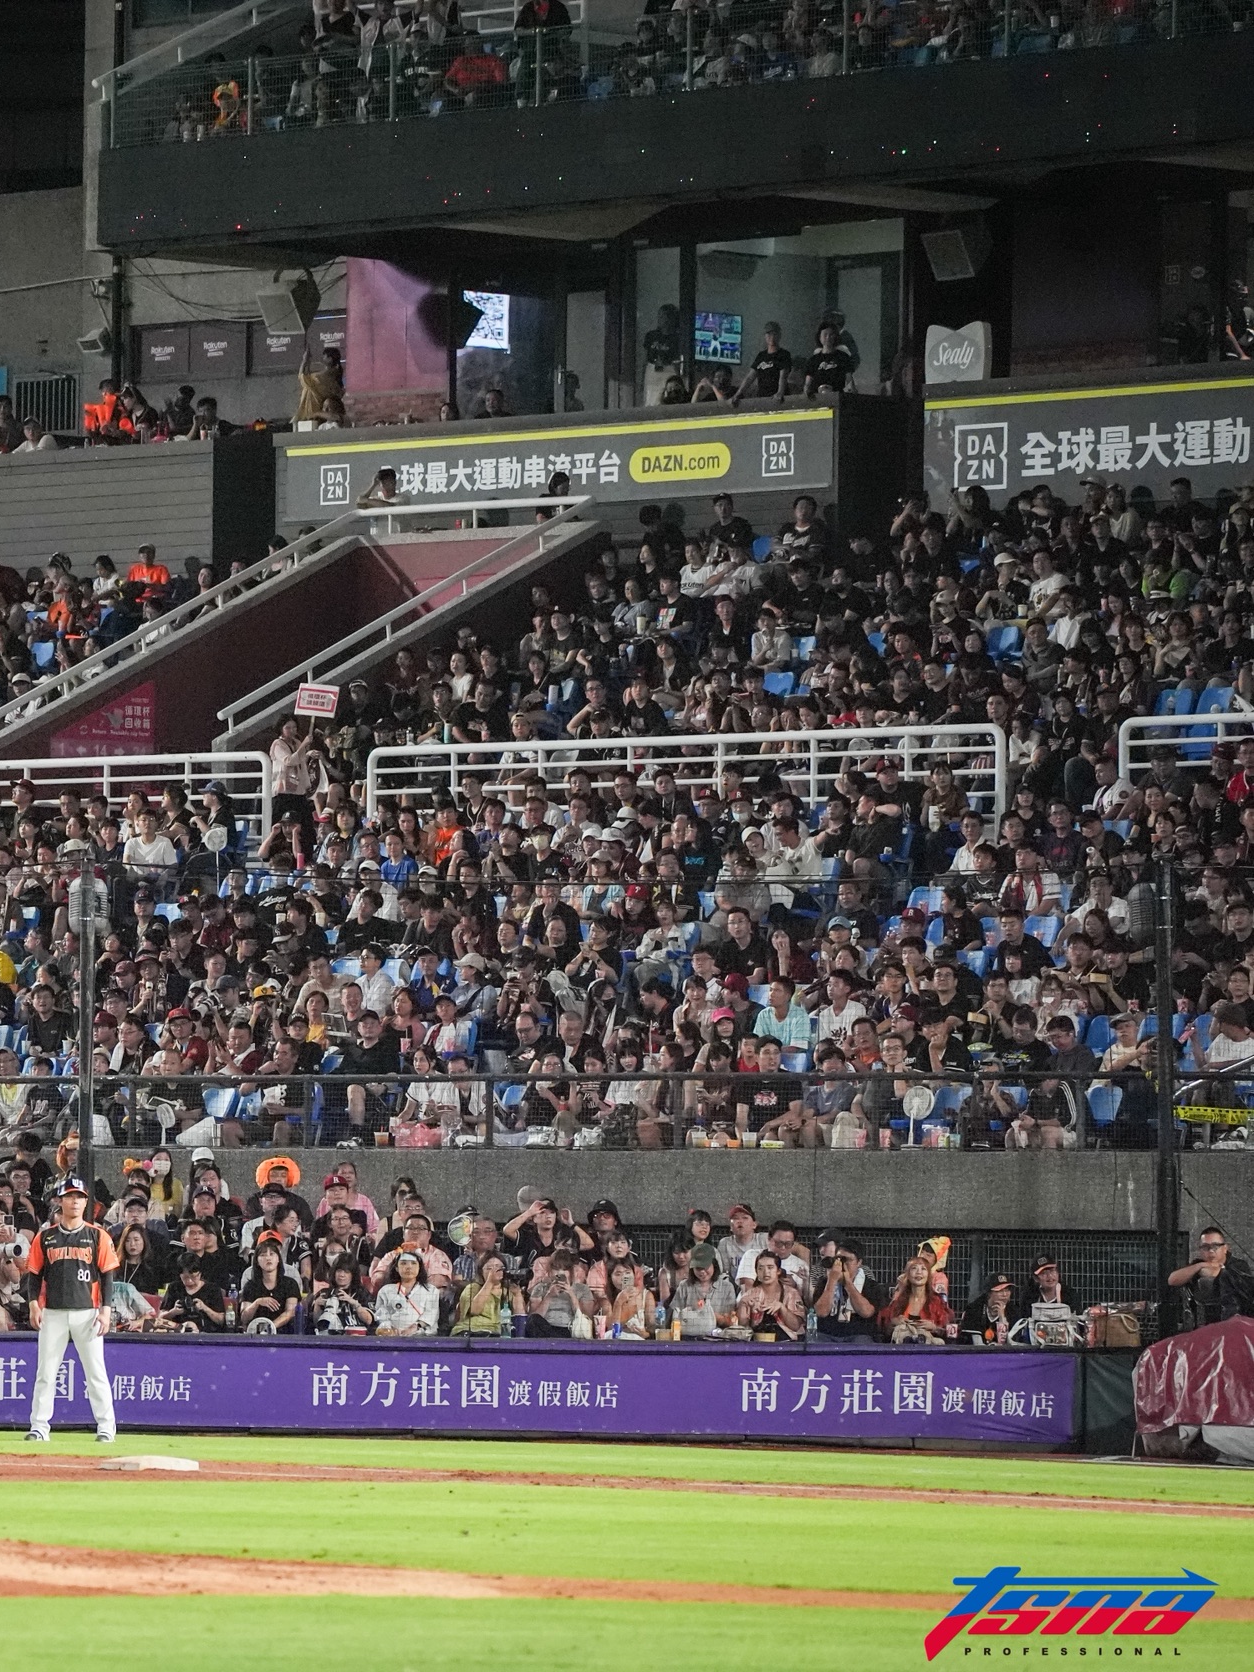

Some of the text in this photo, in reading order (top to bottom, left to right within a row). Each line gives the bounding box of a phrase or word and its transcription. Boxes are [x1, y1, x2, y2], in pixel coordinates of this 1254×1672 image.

[933, 341, 974, 369] Sealy
[641, 454, 720, 474] DAZN.com
[77, 1268, 91, 1283] 80
